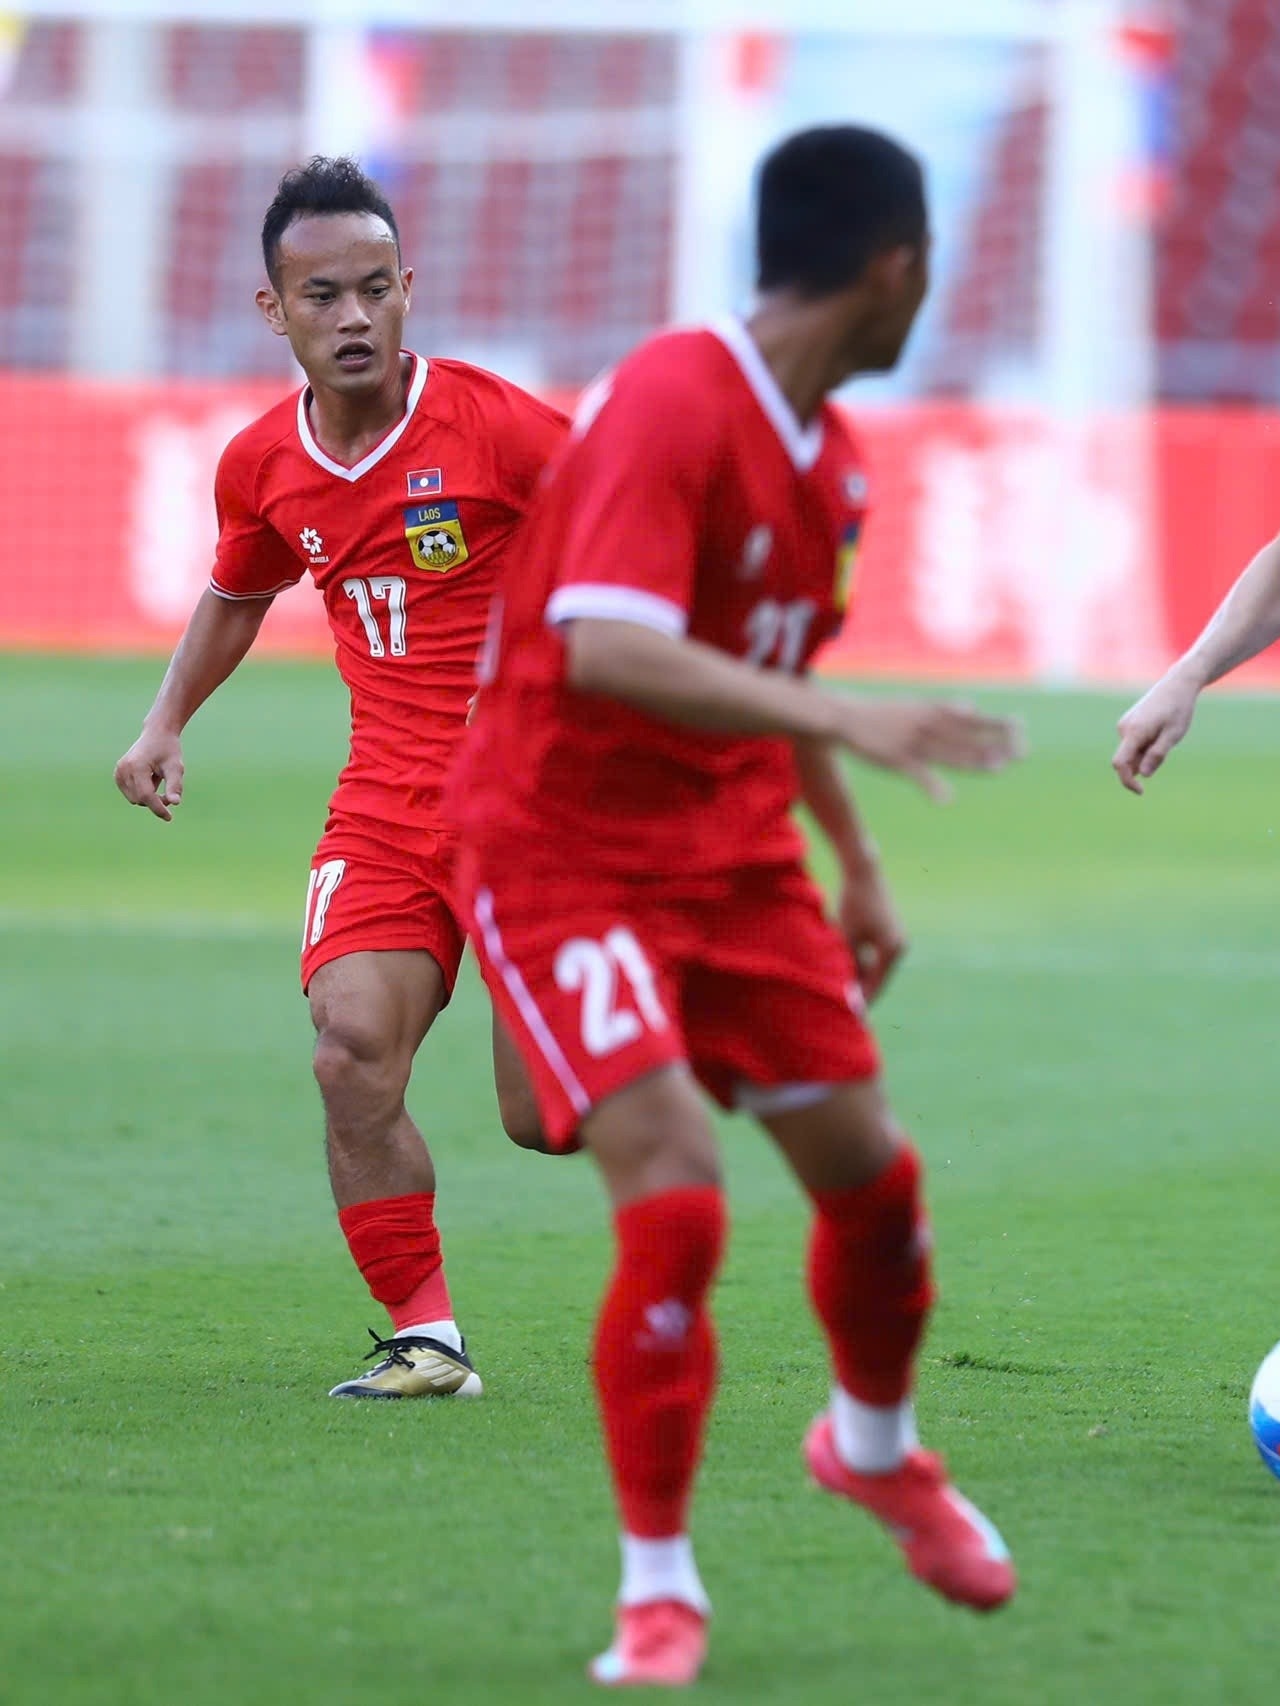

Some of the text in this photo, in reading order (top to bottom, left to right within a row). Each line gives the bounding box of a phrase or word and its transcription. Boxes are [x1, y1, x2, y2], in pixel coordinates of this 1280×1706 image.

[418, 507, 441, 522] LAOS
[343, 576, 408, 658] 17
[553, 925, 669, 1058] 21
